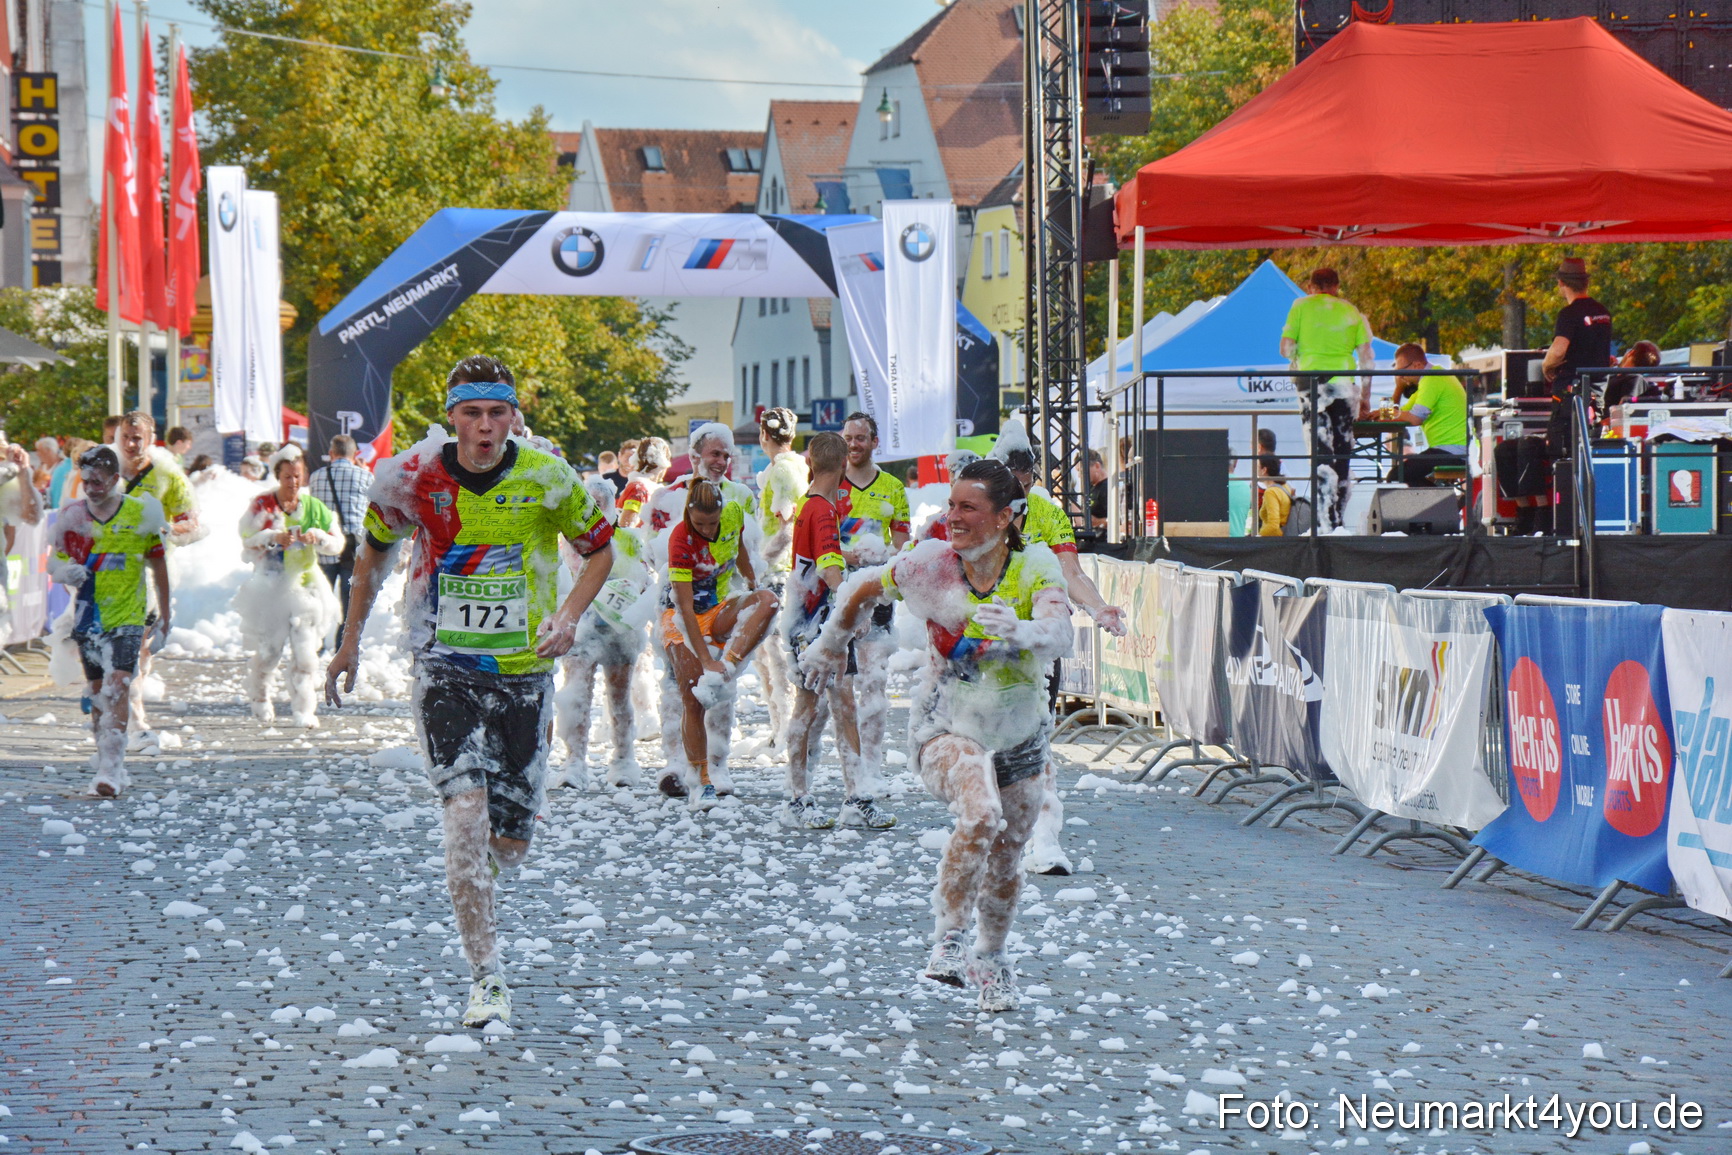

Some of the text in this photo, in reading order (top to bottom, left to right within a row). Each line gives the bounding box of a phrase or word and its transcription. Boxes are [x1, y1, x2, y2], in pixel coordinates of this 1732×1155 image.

[338, 262, 460, 345] PARTL NEUMARKT
[446, 580, 519, 598] BOCK
[459, 604, 508, 628] 172
[1565, 684, 1581, 705] STORE
[1508, 690, 1559, 790] Hervis
[1571, 734, 1591, 756] ONLINE
[1604, 698, 1664, 803] Hervis
[1575, 784, 1595, 807] MOBILE
[1606, 789, 1632, 812] SPORTS
